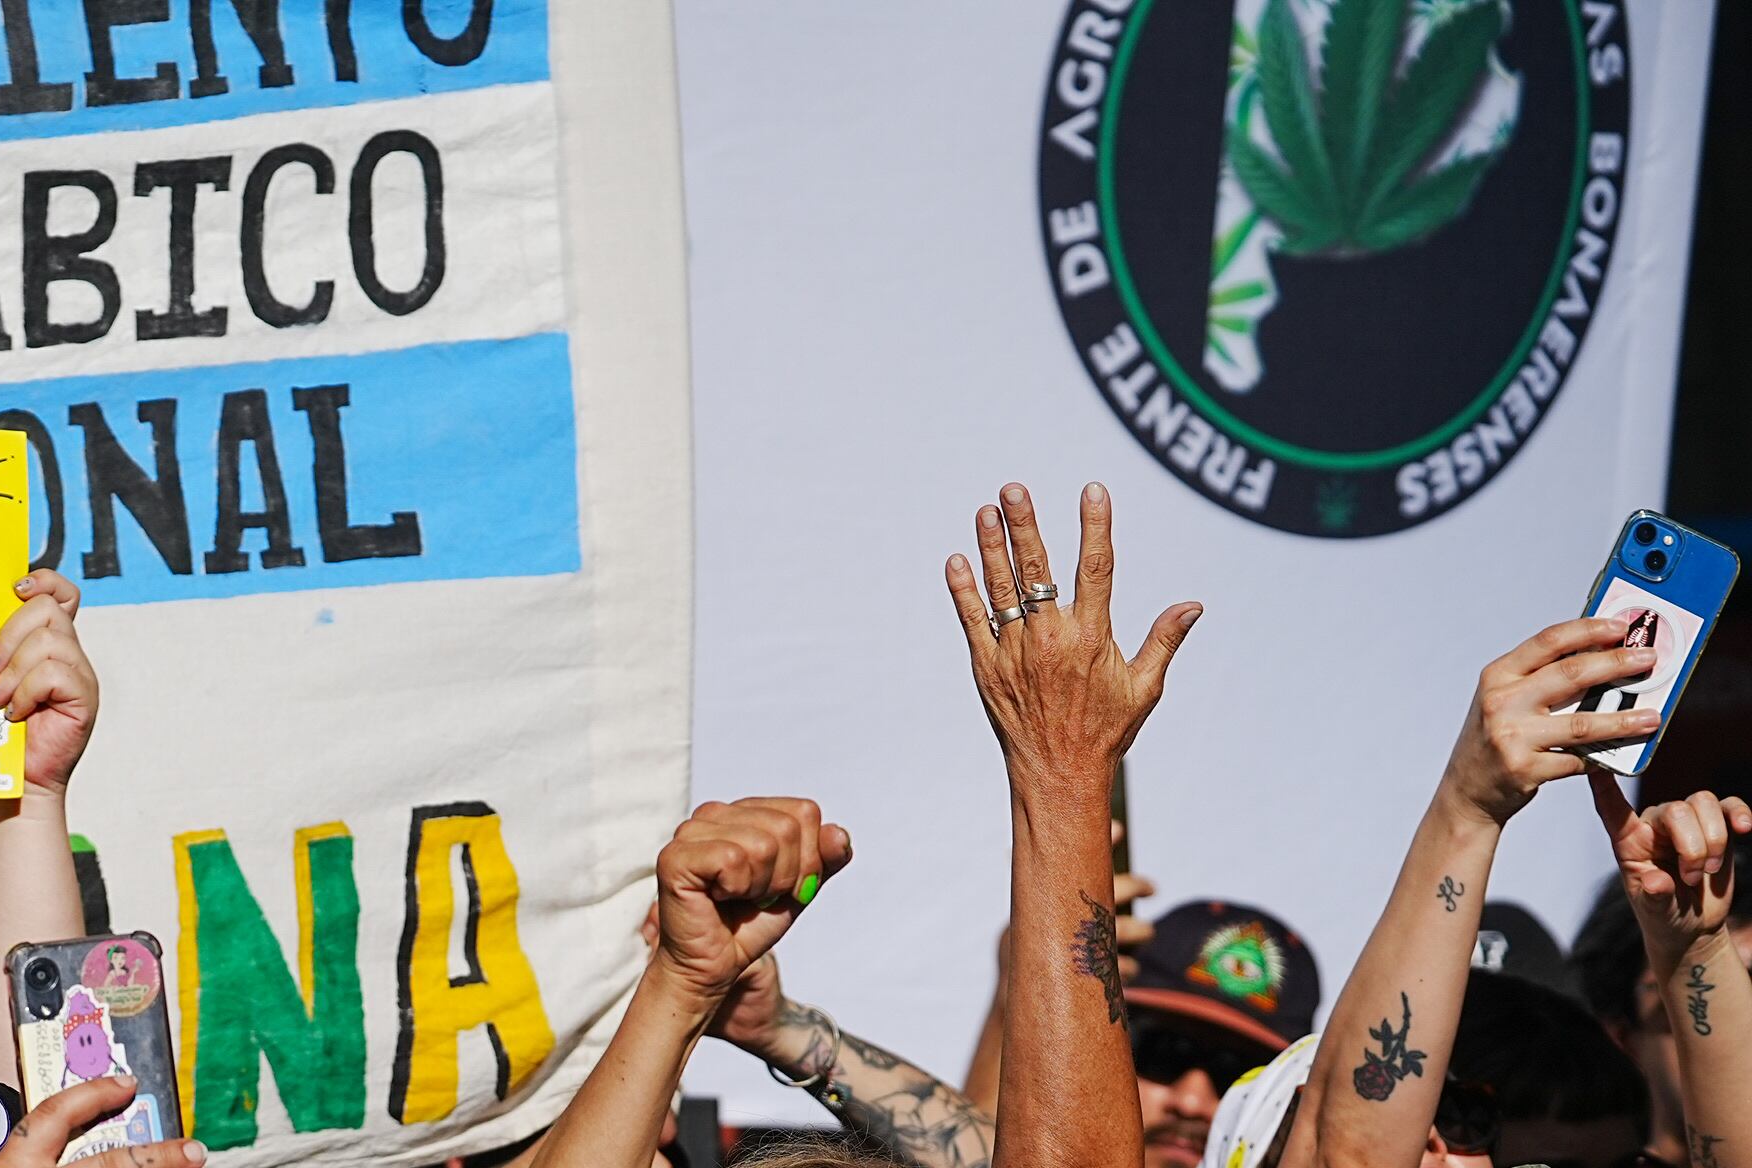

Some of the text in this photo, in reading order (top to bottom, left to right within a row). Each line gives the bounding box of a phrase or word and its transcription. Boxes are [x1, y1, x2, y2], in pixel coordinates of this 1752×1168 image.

[1050, 200, 1111, 298] DE
[1395, 131, 1625, 517] BONAERENSES
[1088, 322, 1277, 512] FRENTE
